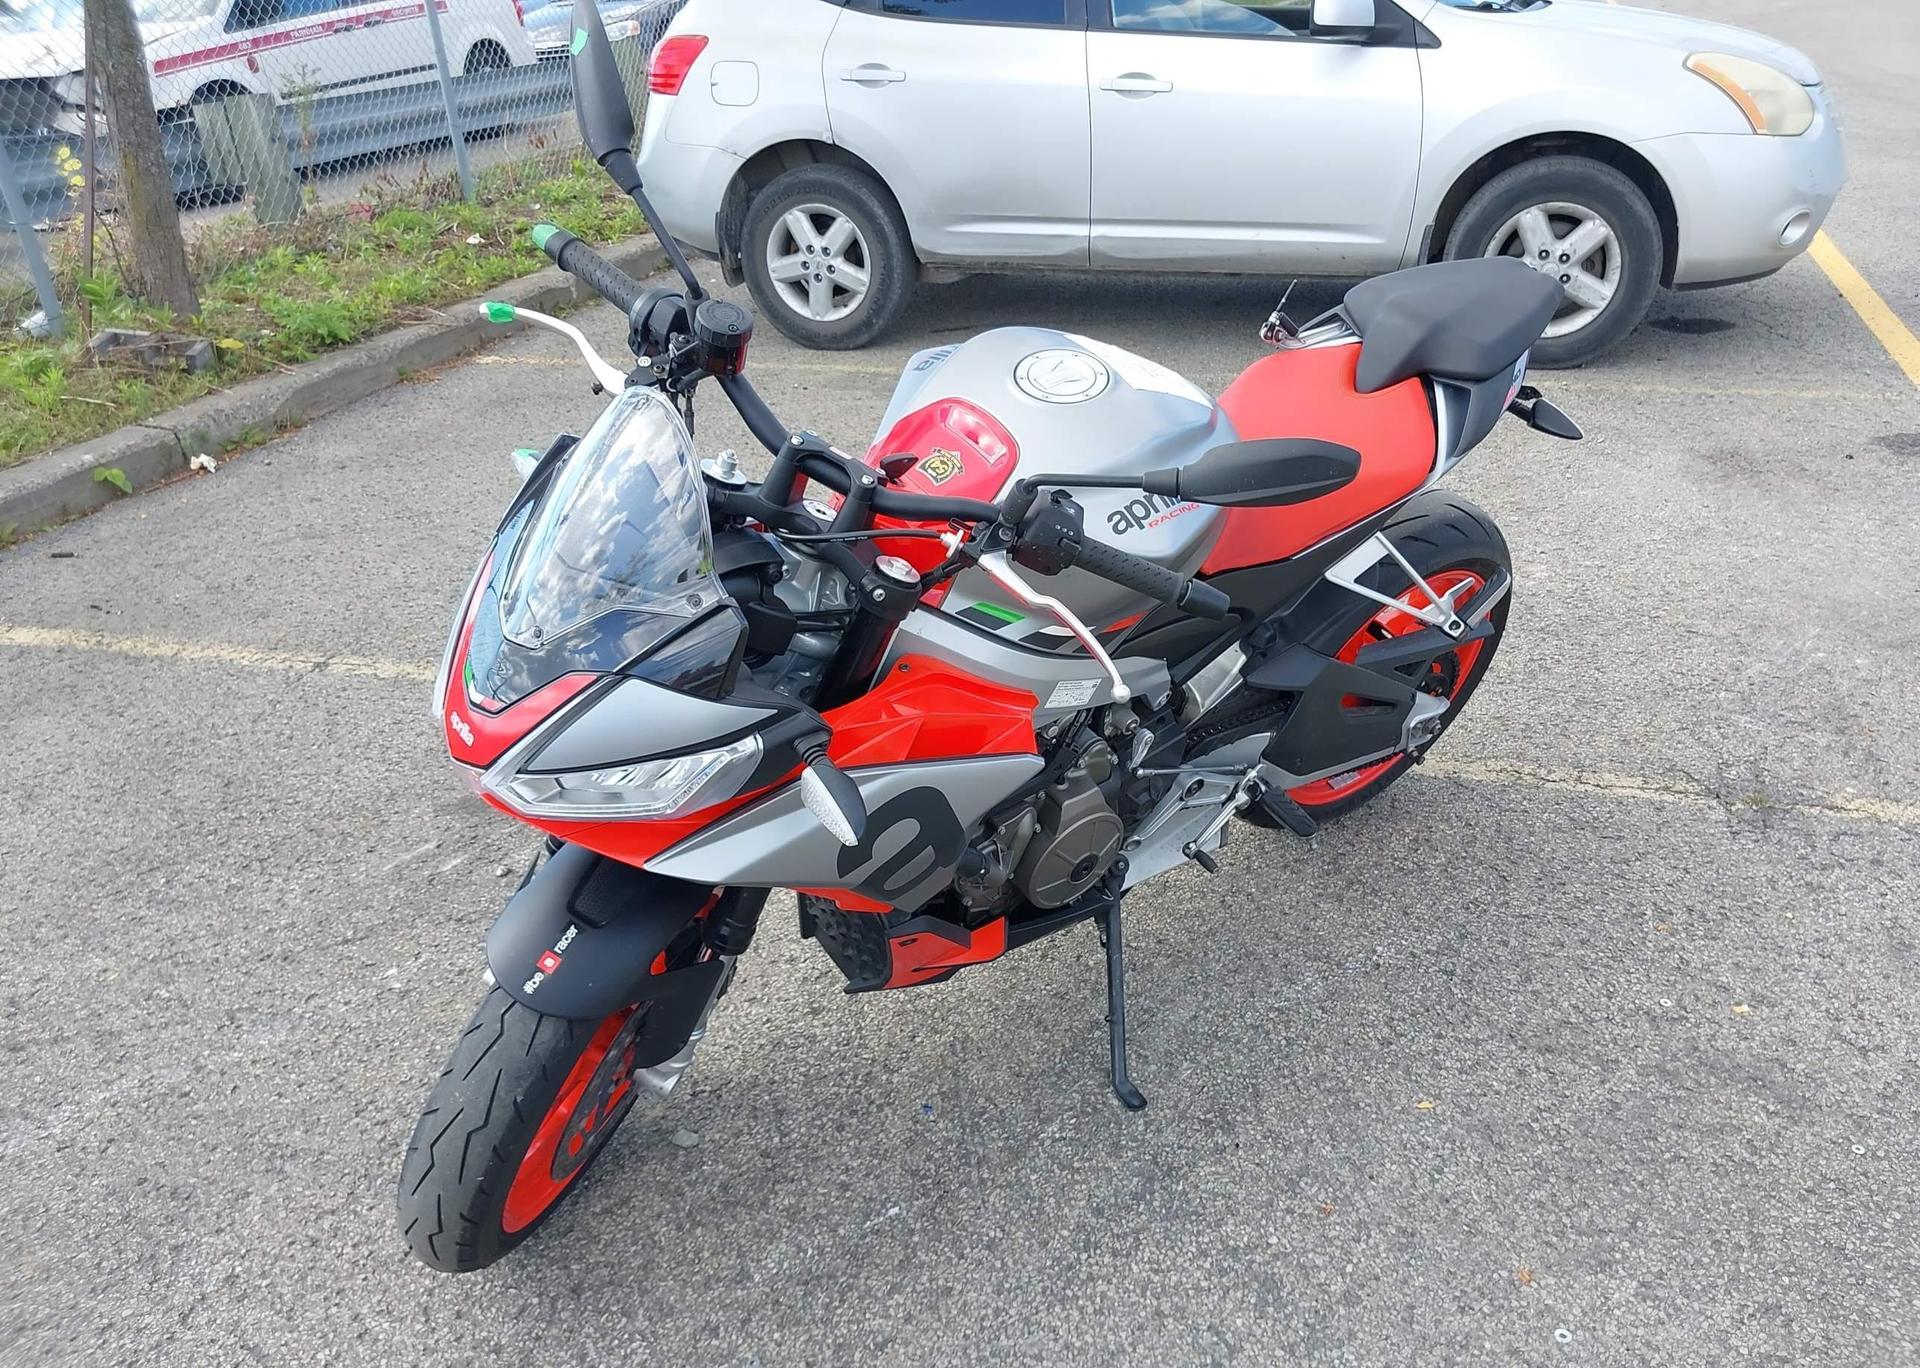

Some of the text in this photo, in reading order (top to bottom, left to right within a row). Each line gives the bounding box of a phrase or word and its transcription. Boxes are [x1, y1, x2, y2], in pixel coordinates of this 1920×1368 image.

[1148, 502, 1200, 529] RACING
[522, 971, 545, 995] #be
[553, 924, 579, 954] racer
